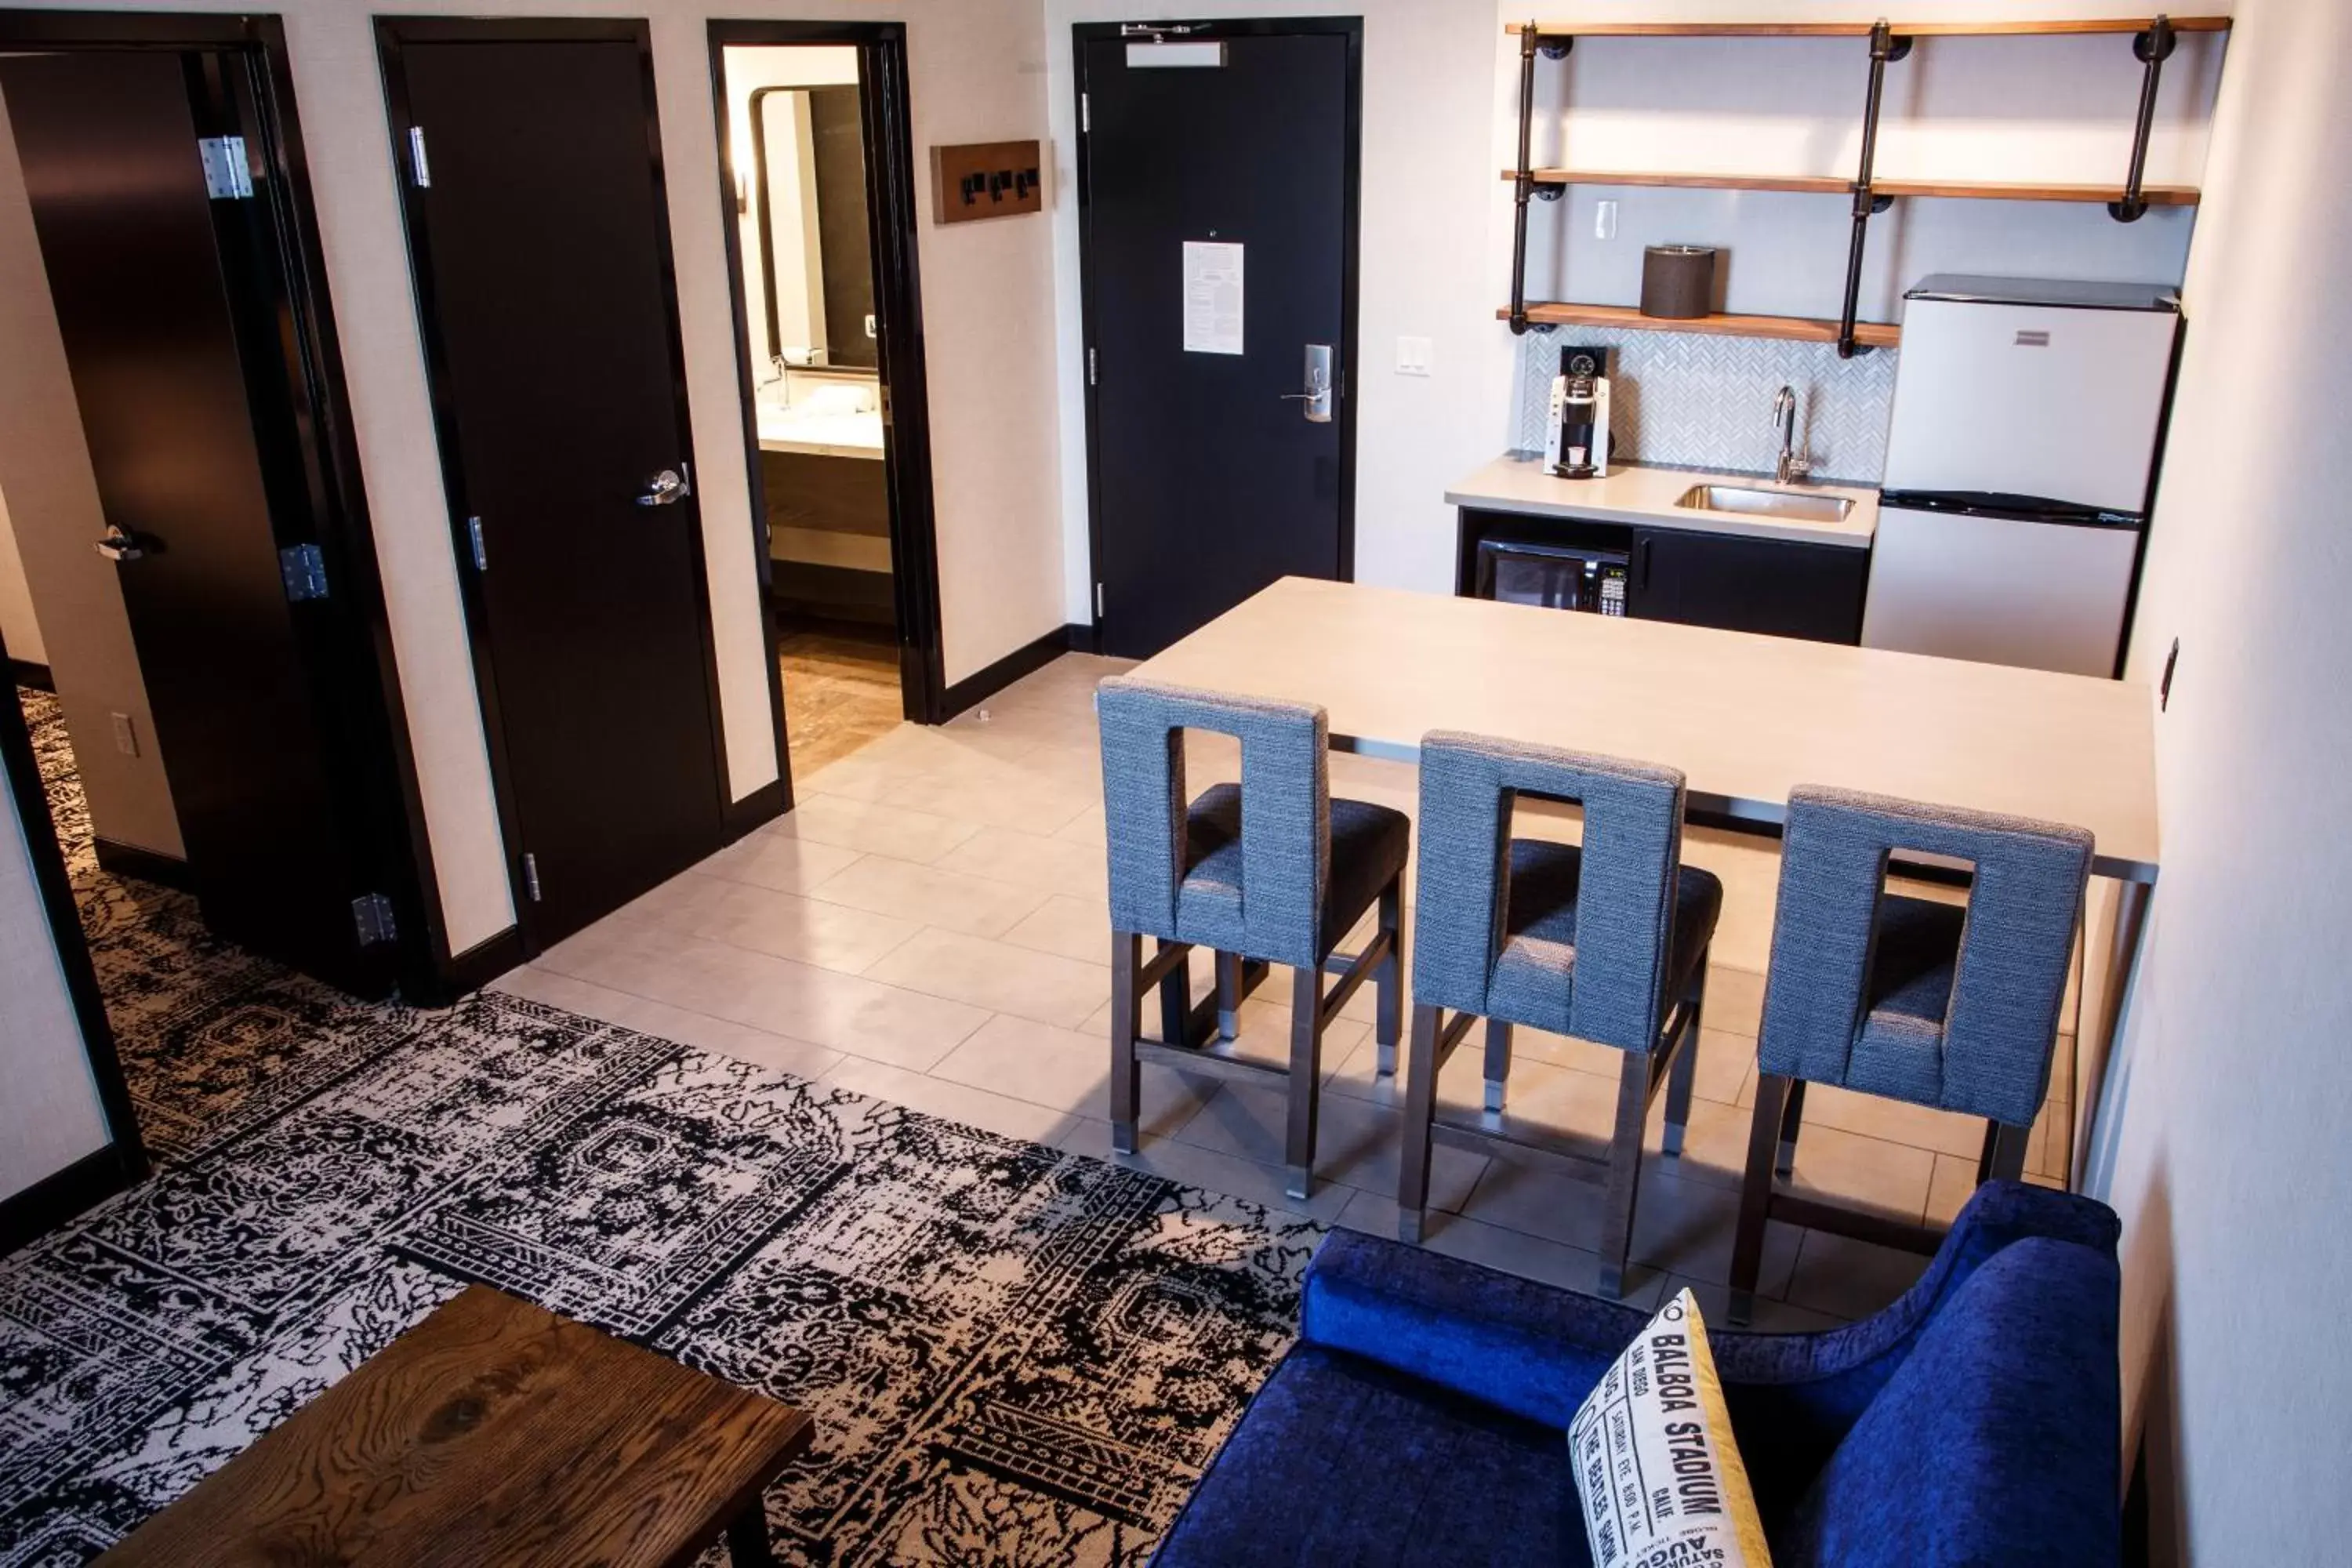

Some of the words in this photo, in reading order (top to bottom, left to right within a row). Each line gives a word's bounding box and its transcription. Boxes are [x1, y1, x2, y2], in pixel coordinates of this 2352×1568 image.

[1651, 1334, 1697, 1413] BALBOA
[1585, 1426, 1600, 1461] THE
[1612, 1411, 1628, 1455] SATURDAY
[1623, 1483, 1638, 1508] 8:00
[1632, 1367, 1649, 1397] DIEGO
[1652, 1487, 1674, 1523] CALIF.
[1664, 1422, 1722, 1515] STADIUM
[1588, 1457, 1609, 1522] BEATLES
[1598, 1519, 1617, 1568] SHOW
